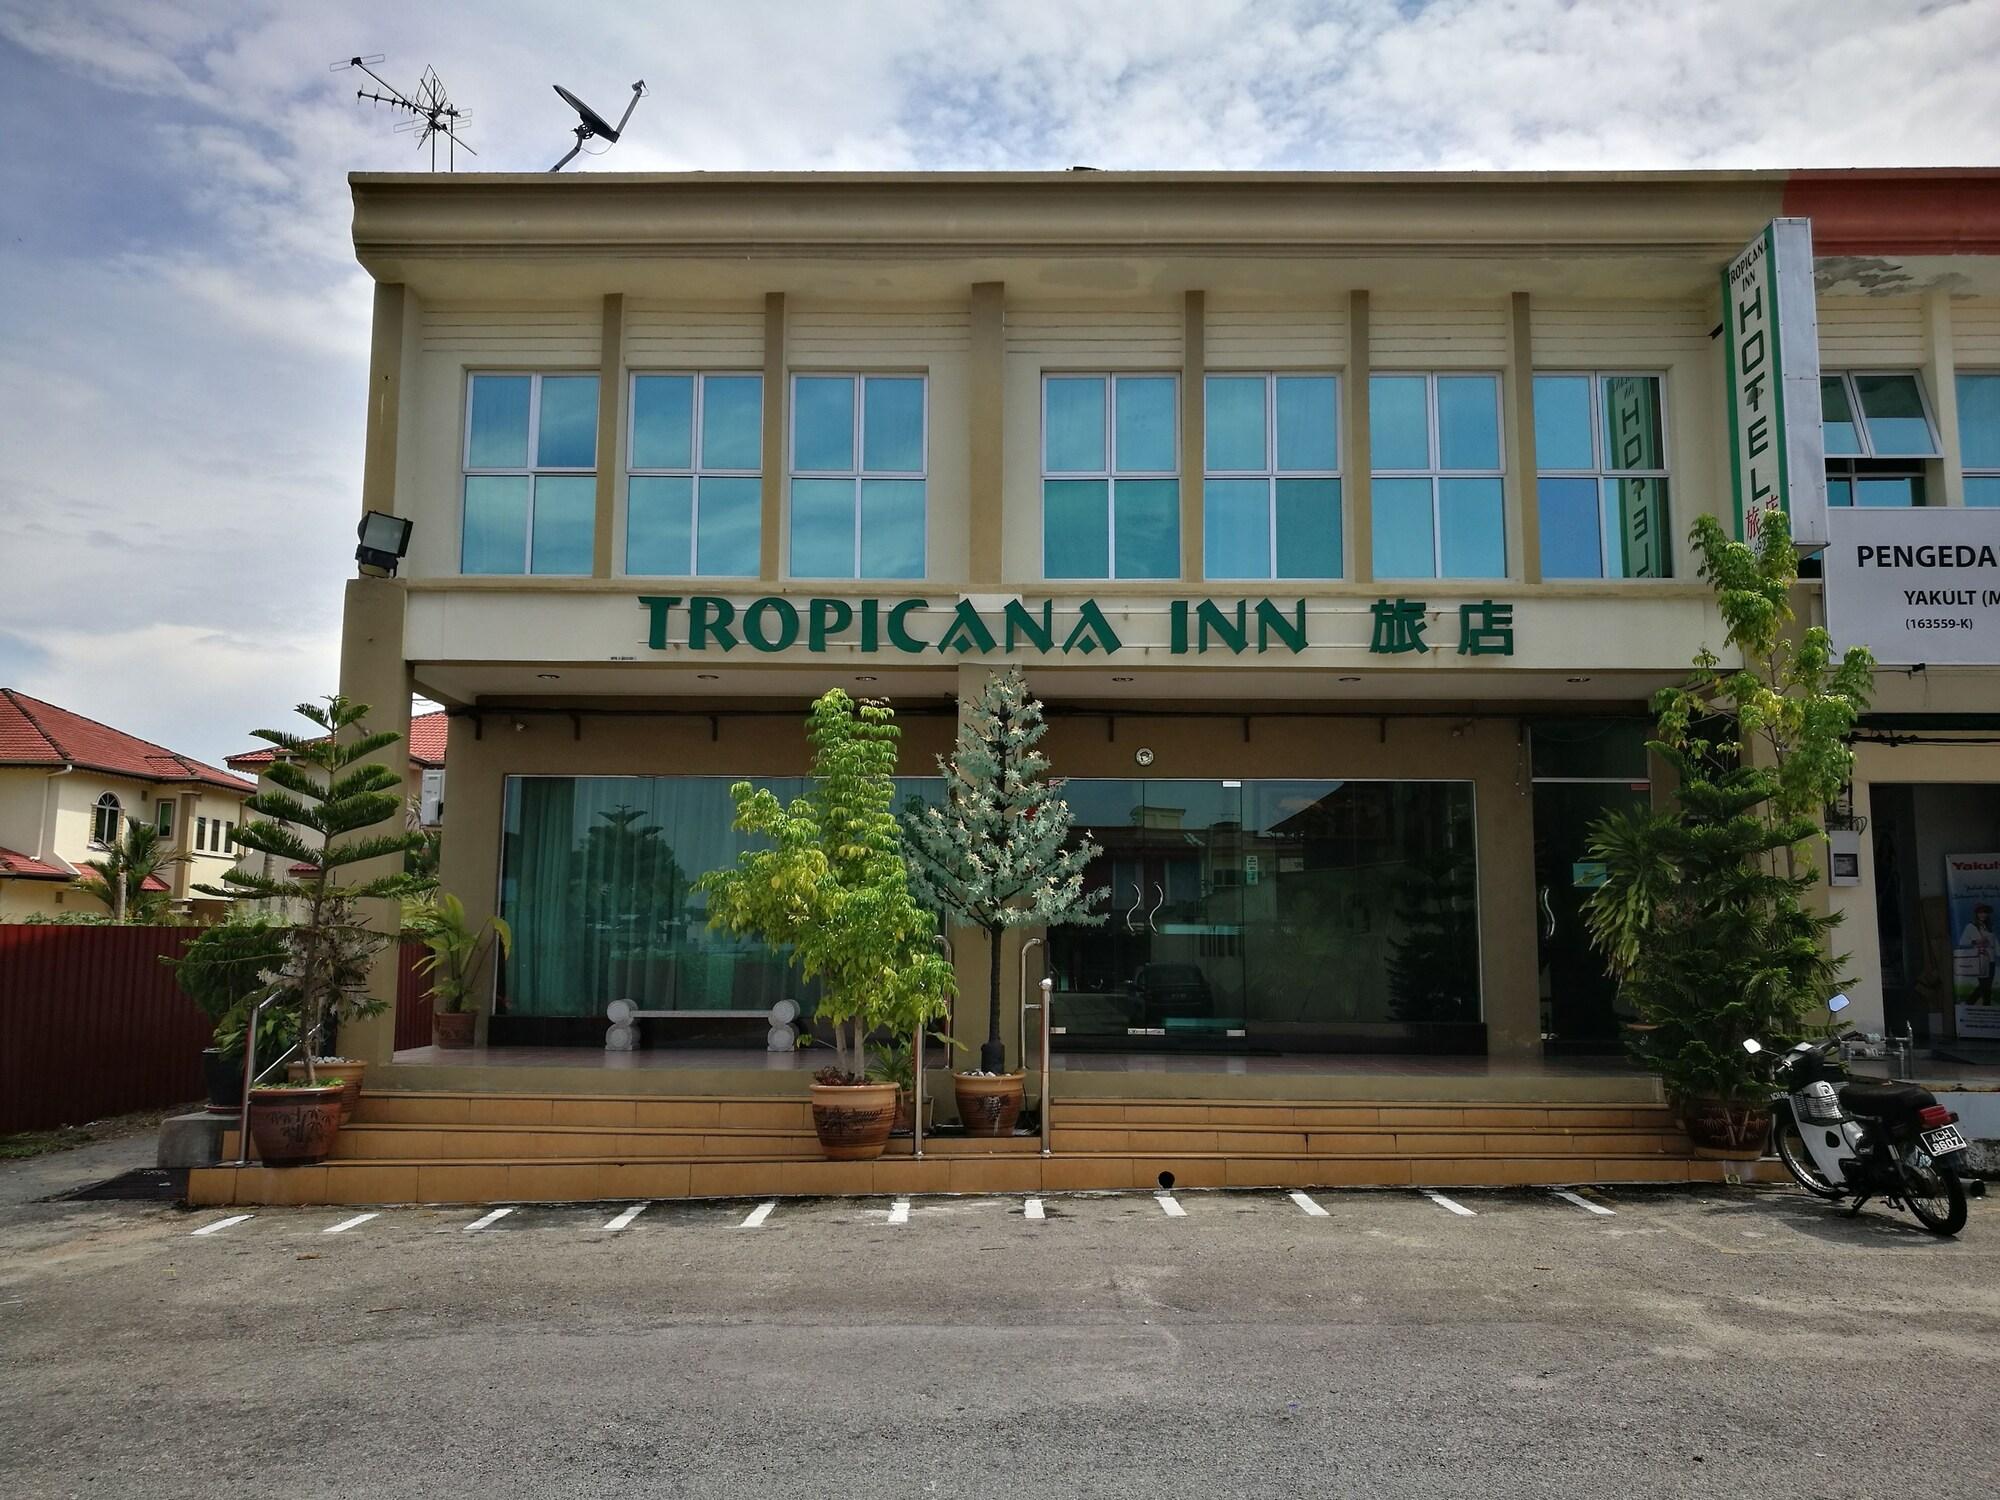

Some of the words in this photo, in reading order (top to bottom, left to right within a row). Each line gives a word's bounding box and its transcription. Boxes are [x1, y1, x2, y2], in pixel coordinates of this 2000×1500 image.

[1727, 238, 1769, 288] TROPICANA
[1742, 269, 1756, 293] INN
[1739, 285, 1771, 503] HOTEL
[1857, 545, 2000, 568] PENGEDA
[1904, 590, 1977, 606] YAKULT
[637, 596, 1123, 655] TROPICANA
[1170, 598, 1309, 655] INN
[1369, 598, 1514, 656] 旅店
[1905, 618, 1973, 631] (163559-K)
[1952, 861, 2000, 870] Yakul
[1931, 1129, 1952, 1142] ACH
